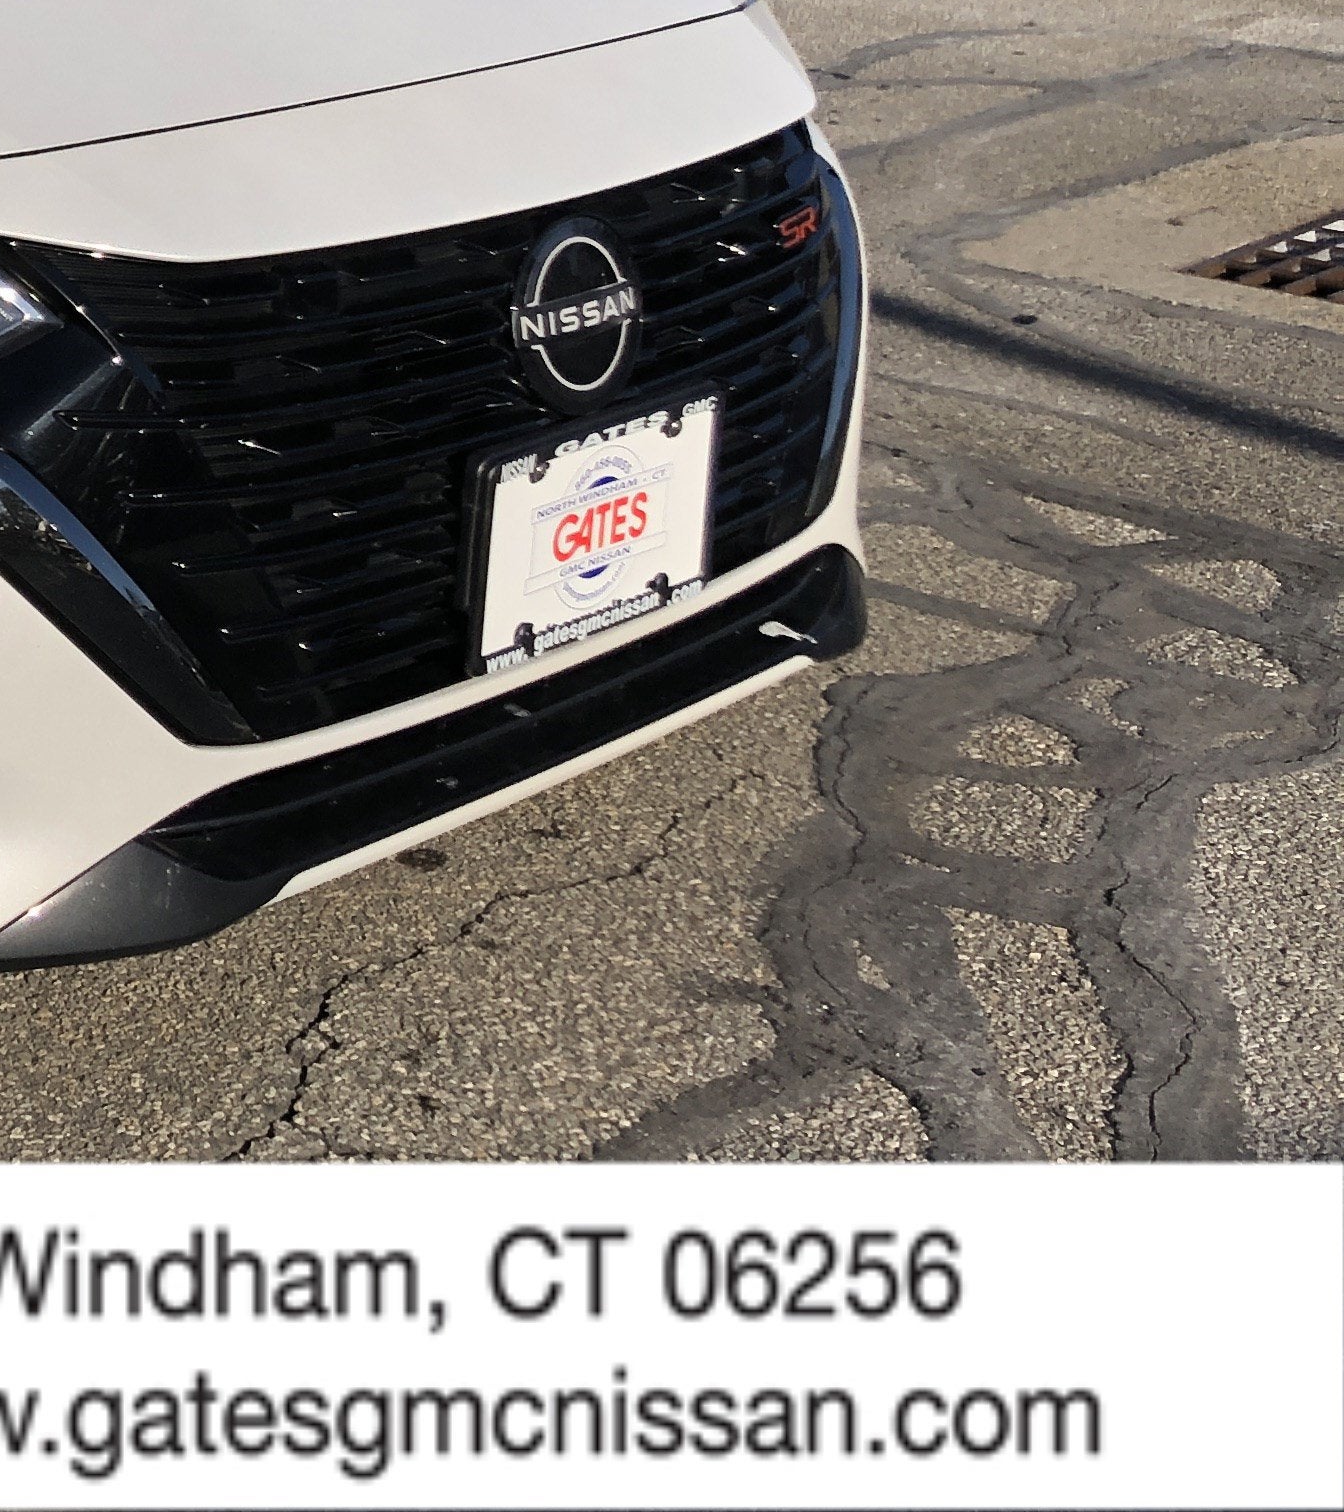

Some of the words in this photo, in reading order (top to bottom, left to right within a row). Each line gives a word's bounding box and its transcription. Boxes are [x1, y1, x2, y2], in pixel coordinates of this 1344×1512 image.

[777, 206, 819, 248] SR
[519, 285, 636, 341] NISSAN
[555, 411, 669, 457] GATES
[681, 395, 719, 418] GMC
[536, 498, 576, 519] NORTH
[578, 478, 638, 503] WINDHAM
[552, 492, 650, 562] GATES
[560, 562, 585, 577] GMC
[587, 545, 632, 567] NISSAN
